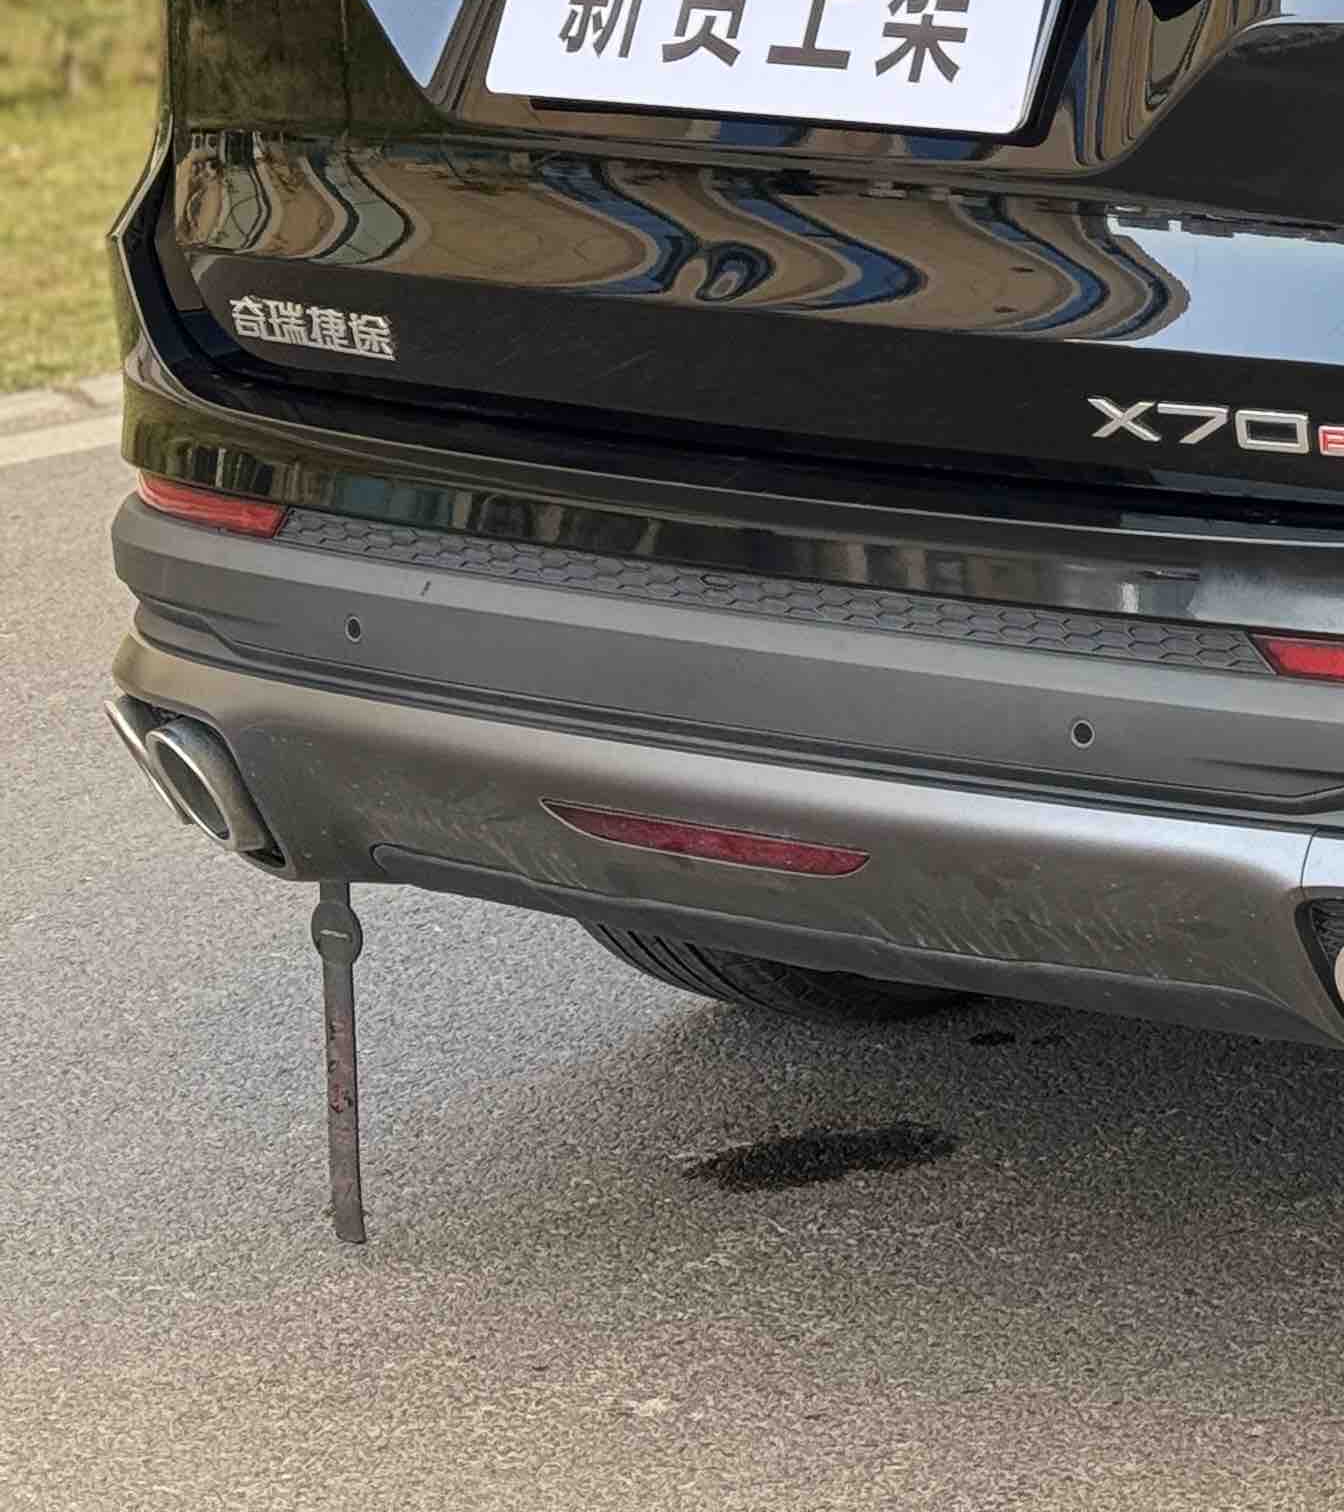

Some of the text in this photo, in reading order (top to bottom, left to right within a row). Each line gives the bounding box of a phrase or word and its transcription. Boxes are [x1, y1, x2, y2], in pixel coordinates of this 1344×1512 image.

[228, 294, 396, 361] 奇瑞捷途
[1086, 395, 1310, 455] X70
